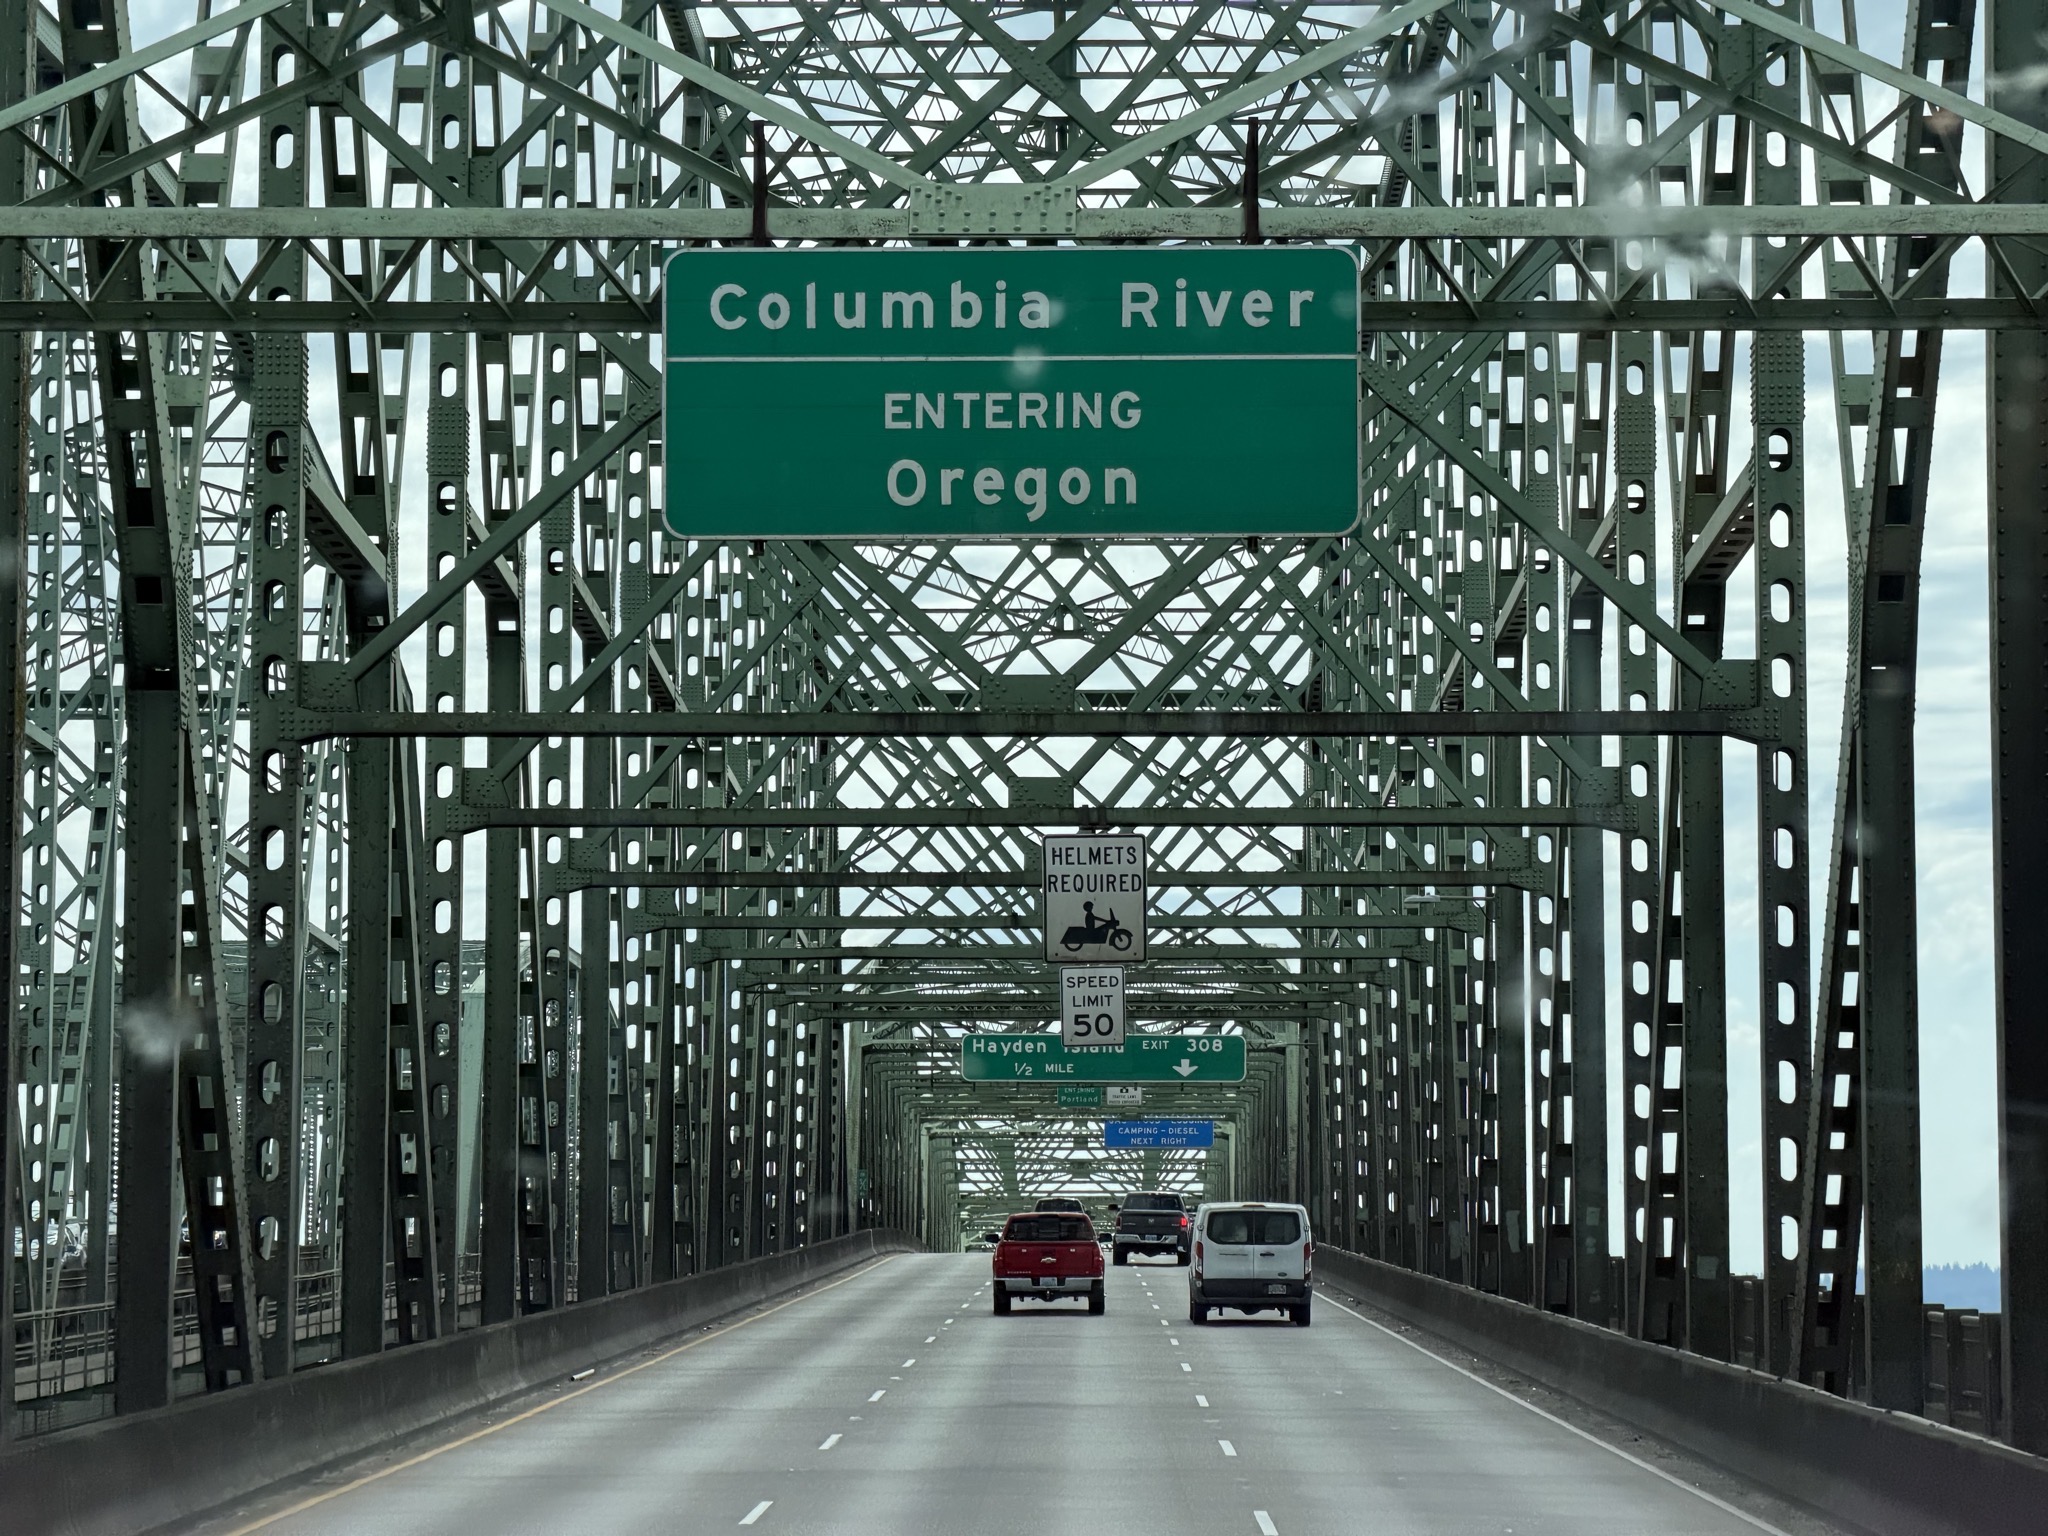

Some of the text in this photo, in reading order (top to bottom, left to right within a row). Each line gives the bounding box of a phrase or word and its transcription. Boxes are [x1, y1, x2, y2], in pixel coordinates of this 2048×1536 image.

[709, 277, 1315, 330] Columbia River
[884, 390, 1142, 429] ENTERING
[886, 459, 1137, 523] Oregon
[1051, 846, 1137, 865] HELMETS
[1047, 874, 1142, 893] REQUIRED
[1066, 975, 1119, 988] SPEED
[1072, 994, 1114, 1007] LIMIT
[1073, 1013, 1114, 1037] 50
[972, 1038, 1047, 1057] Hayden
[1142, 1040, 1170, 1050] EXIT
[1186, 1038, 1223, 1052] 308
[1045, 1063, 1075, 1073] MILE
[1060, 1095, 1098, 1103] Portland
[1118, 1127, 1158, 1135] CAMPING
[1168, 1127, 1200, 1135] DIESEL
[1130, 1137, 1187, 1145] NEXT RIGHT
